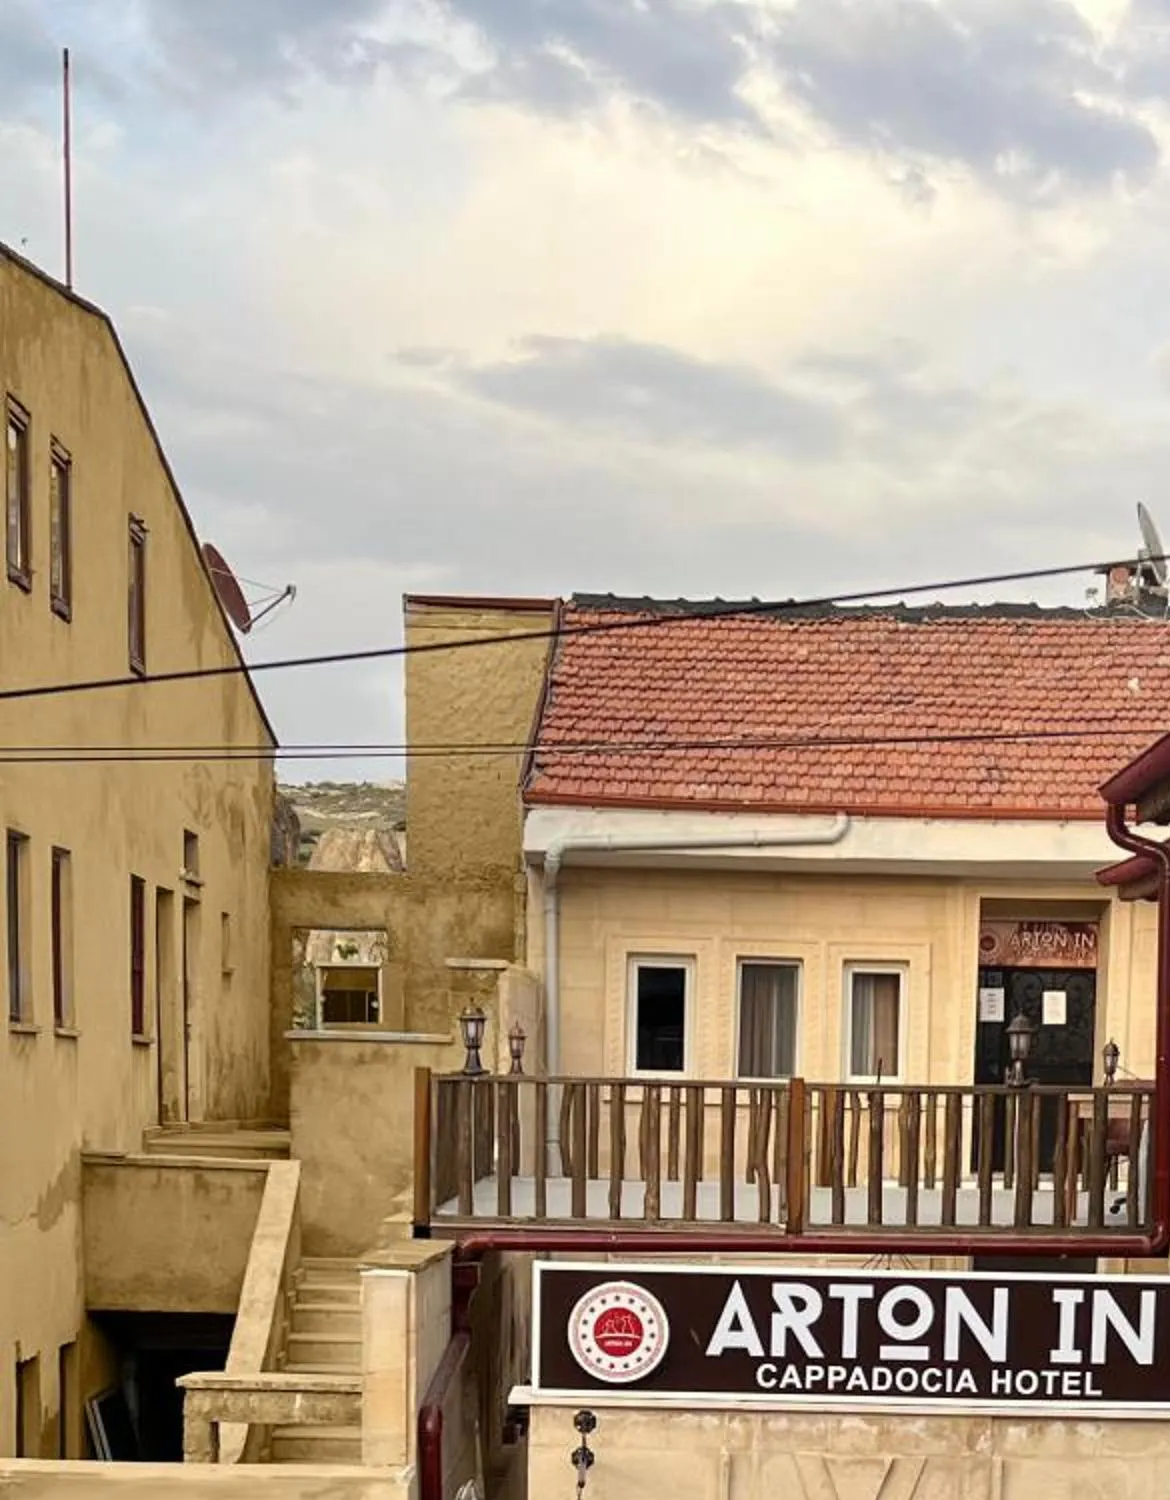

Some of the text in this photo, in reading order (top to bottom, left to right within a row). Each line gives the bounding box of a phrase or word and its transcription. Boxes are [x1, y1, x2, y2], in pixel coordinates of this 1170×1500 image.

[1074, 932, 1096, 948] IN
[705, 1279, 1157, 1365] ARTON IN
[756, 1363, 1103, 1396] CAPPADOCIA HOTEL
